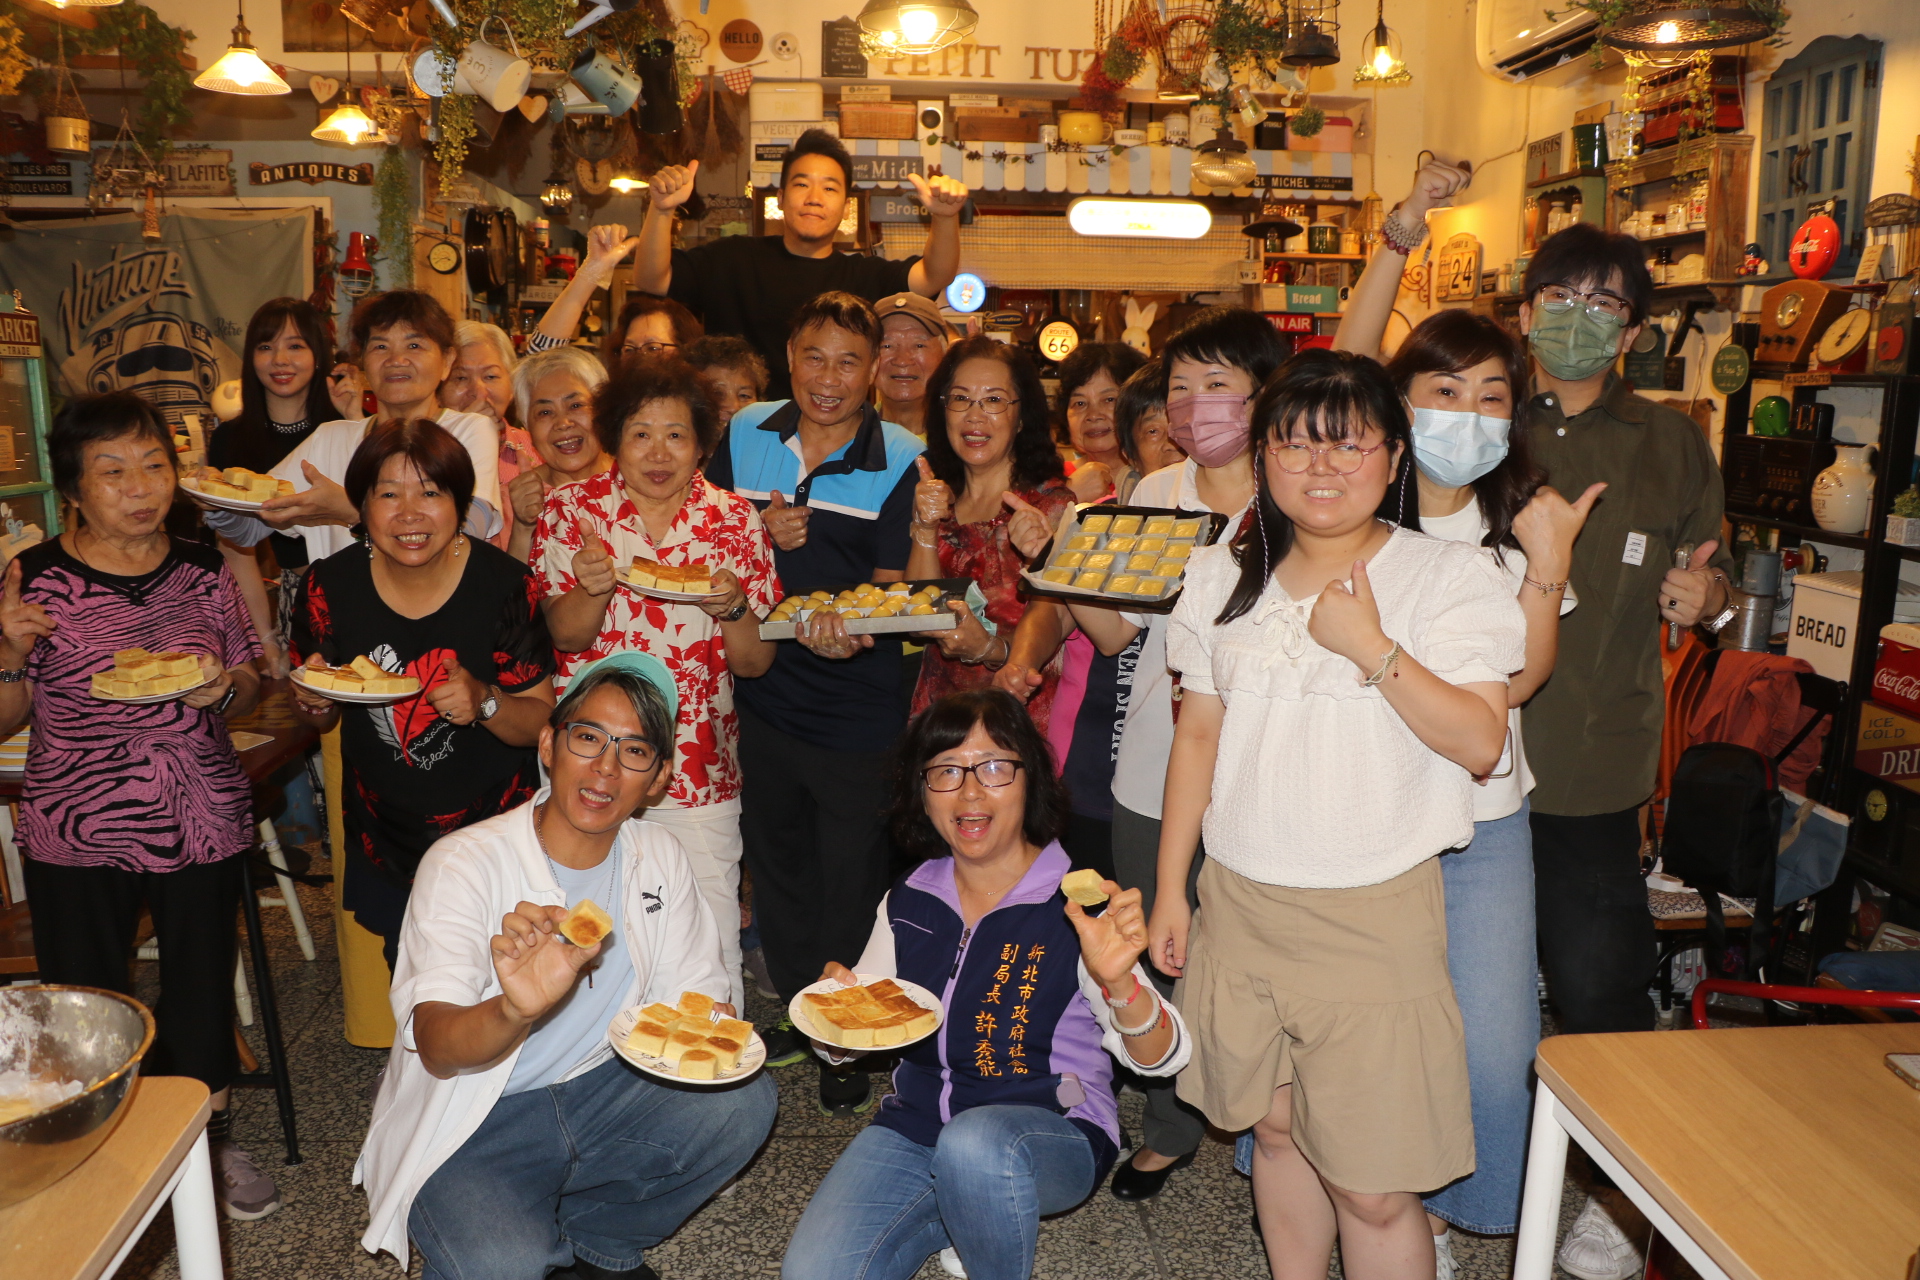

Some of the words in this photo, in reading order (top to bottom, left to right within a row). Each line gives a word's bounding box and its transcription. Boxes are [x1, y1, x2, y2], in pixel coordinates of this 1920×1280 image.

[724, 32, 759, 44] HELLO
[762, 124, 828, 135] VEGETA
[1529, 135, 1562, 160] PARIS
[23, 165, 43, 175] DES
[177, 164, 227, 182] LAFITE
[260, 164, 359, 184] ANTIQUES
[871, 160, 917, 179] Midi
[8, 182, 68, 193] BOULEVARDS
[1271, 176, 1310, 188] MICHEL
[885, 201, 933, 216] Broad
[1451, 256, 1473, 290] 24
[58, 243, 196, 357] Vintage
[1291, 293, 1322, 305] Bread
[214, 316, 243, 339] Retro
[1287, 317, 1312, 331] AIR
[1049, 328, 1070, 336] ROUTE
[1048, 337, 1070, 353] 66
[1795, 615, 1847, 649] BREAD
[1873, 667, 1920, 701] Coca-Cola
[1868, 717, 1894, 729] ICE
[1862, 728, 1905, 740] COLD
[645, 902, 662, 915] PUMA
[980, 943, 1019, 1005] 副局長
